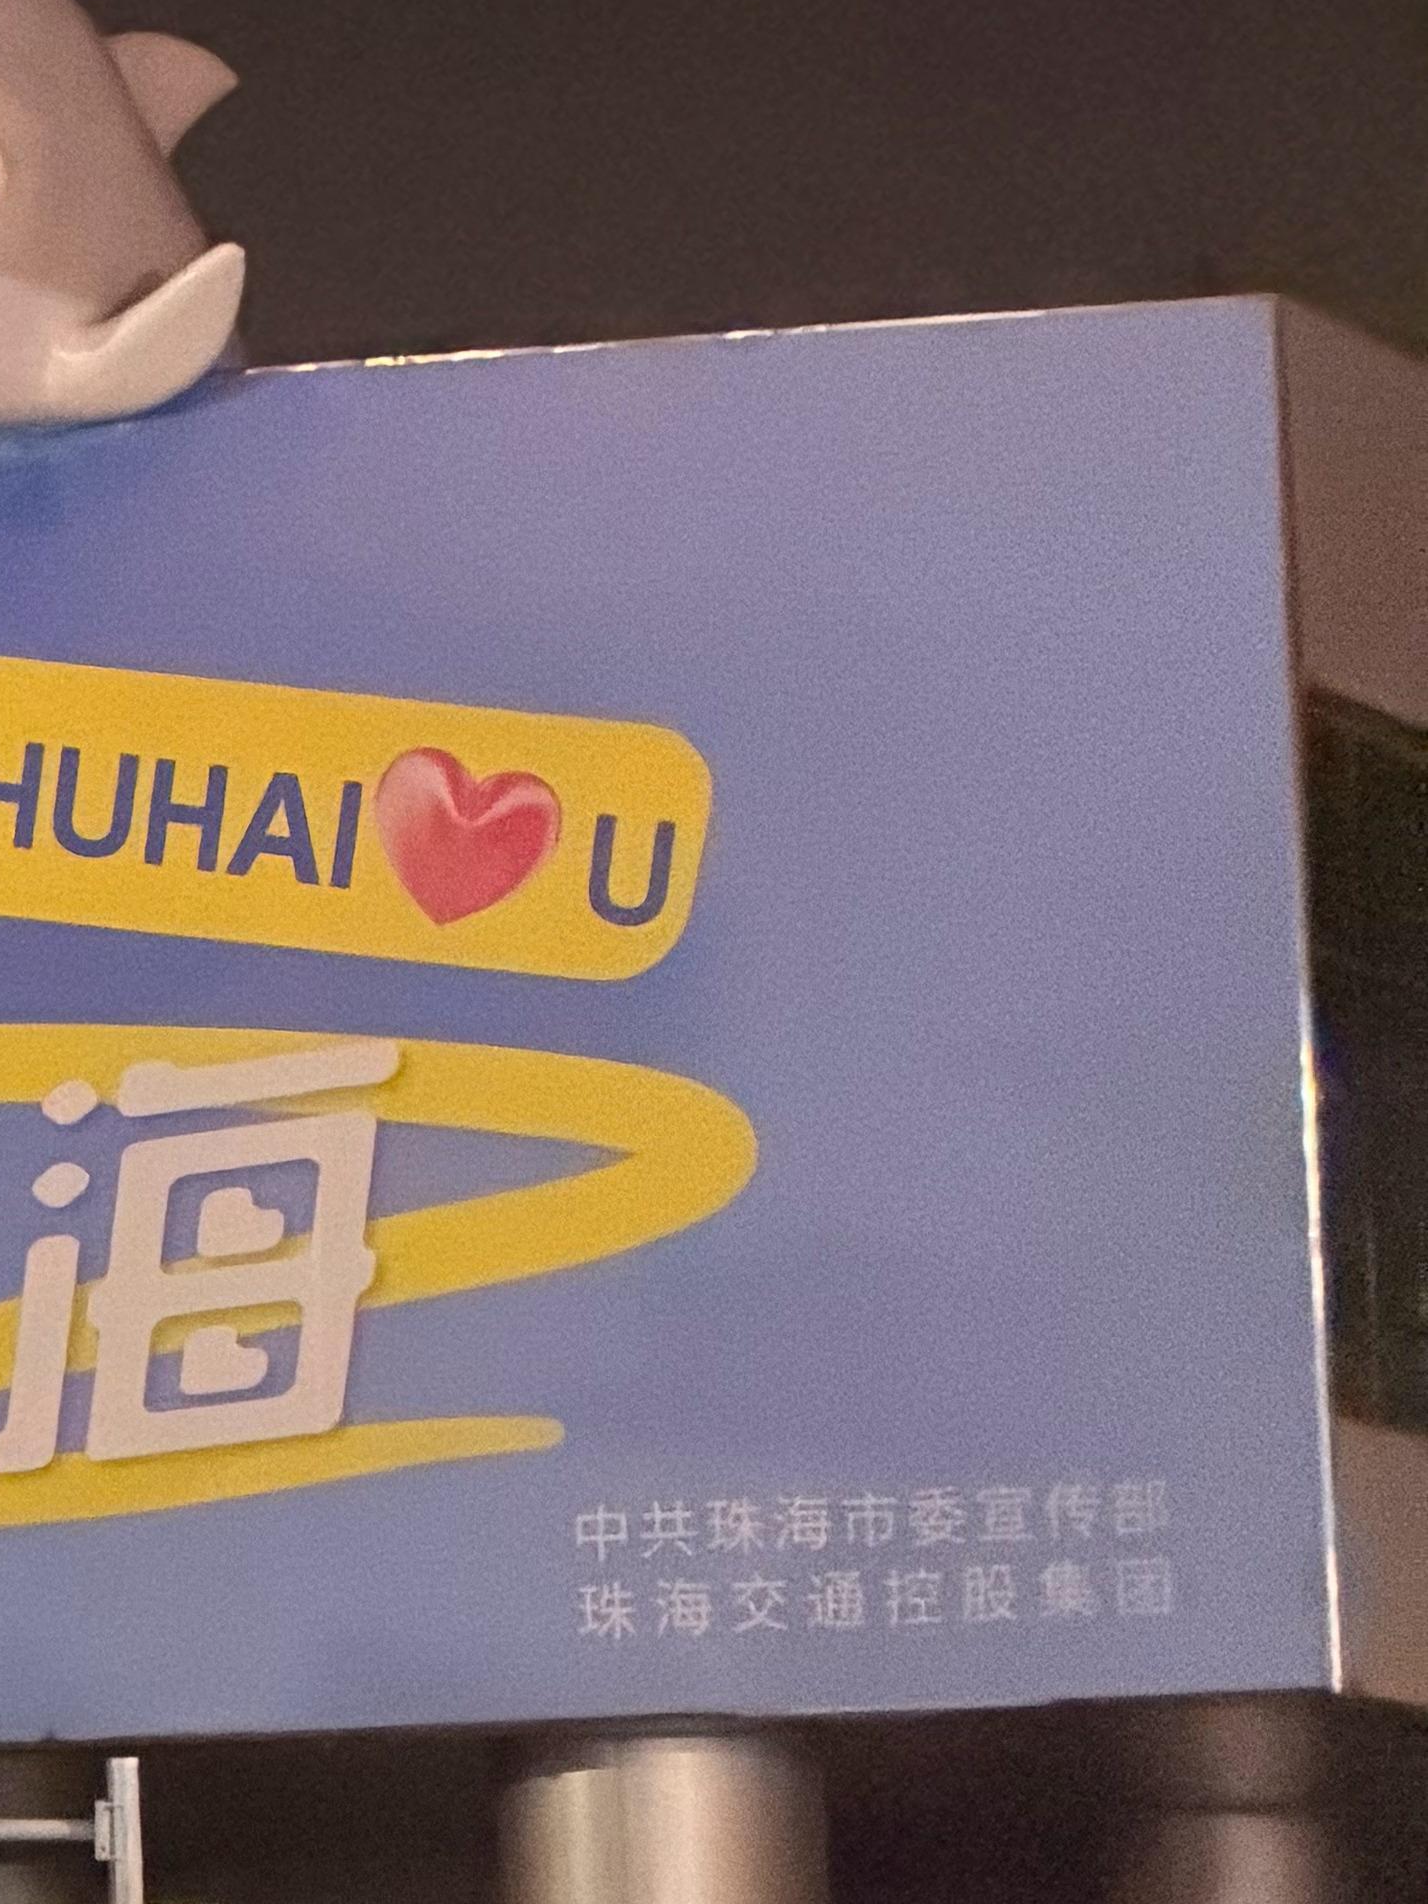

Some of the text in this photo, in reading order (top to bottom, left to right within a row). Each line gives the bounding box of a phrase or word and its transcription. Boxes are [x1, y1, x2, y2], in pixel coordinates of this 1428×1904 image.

[590, 813, 676, 926] U
[575, 1480, 1168, 1562] 中共珠海市委宣传部
[578, 1558, 1172, 1640] 珠海交通控股集团
